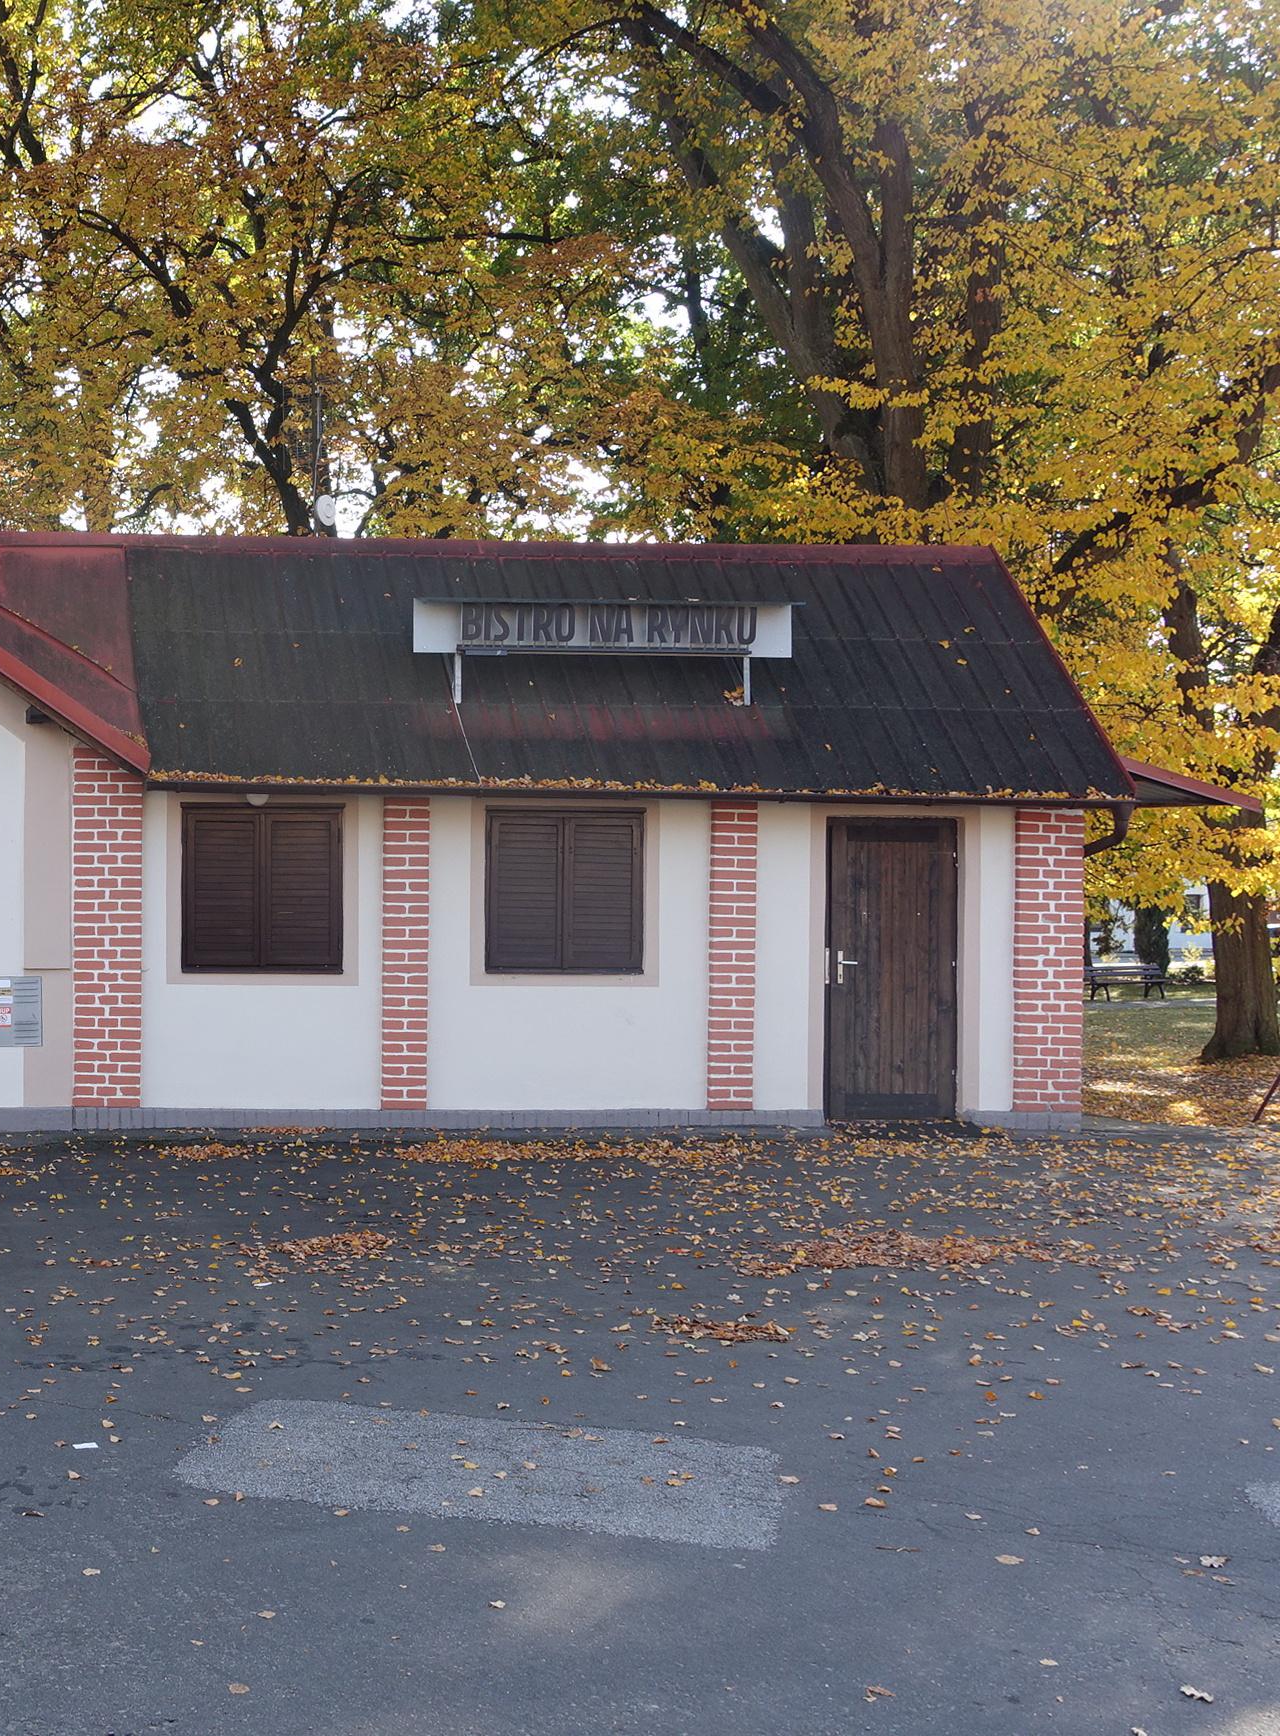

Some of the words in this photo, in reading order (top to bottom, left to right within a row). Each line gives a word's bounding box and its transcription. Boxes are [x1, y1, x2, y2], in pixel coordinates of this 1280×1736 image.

[462, 603, 576, 642] BISTRO
[588, 604, 636, 643] NA
[647, 605, 758, 646] RYNKU
